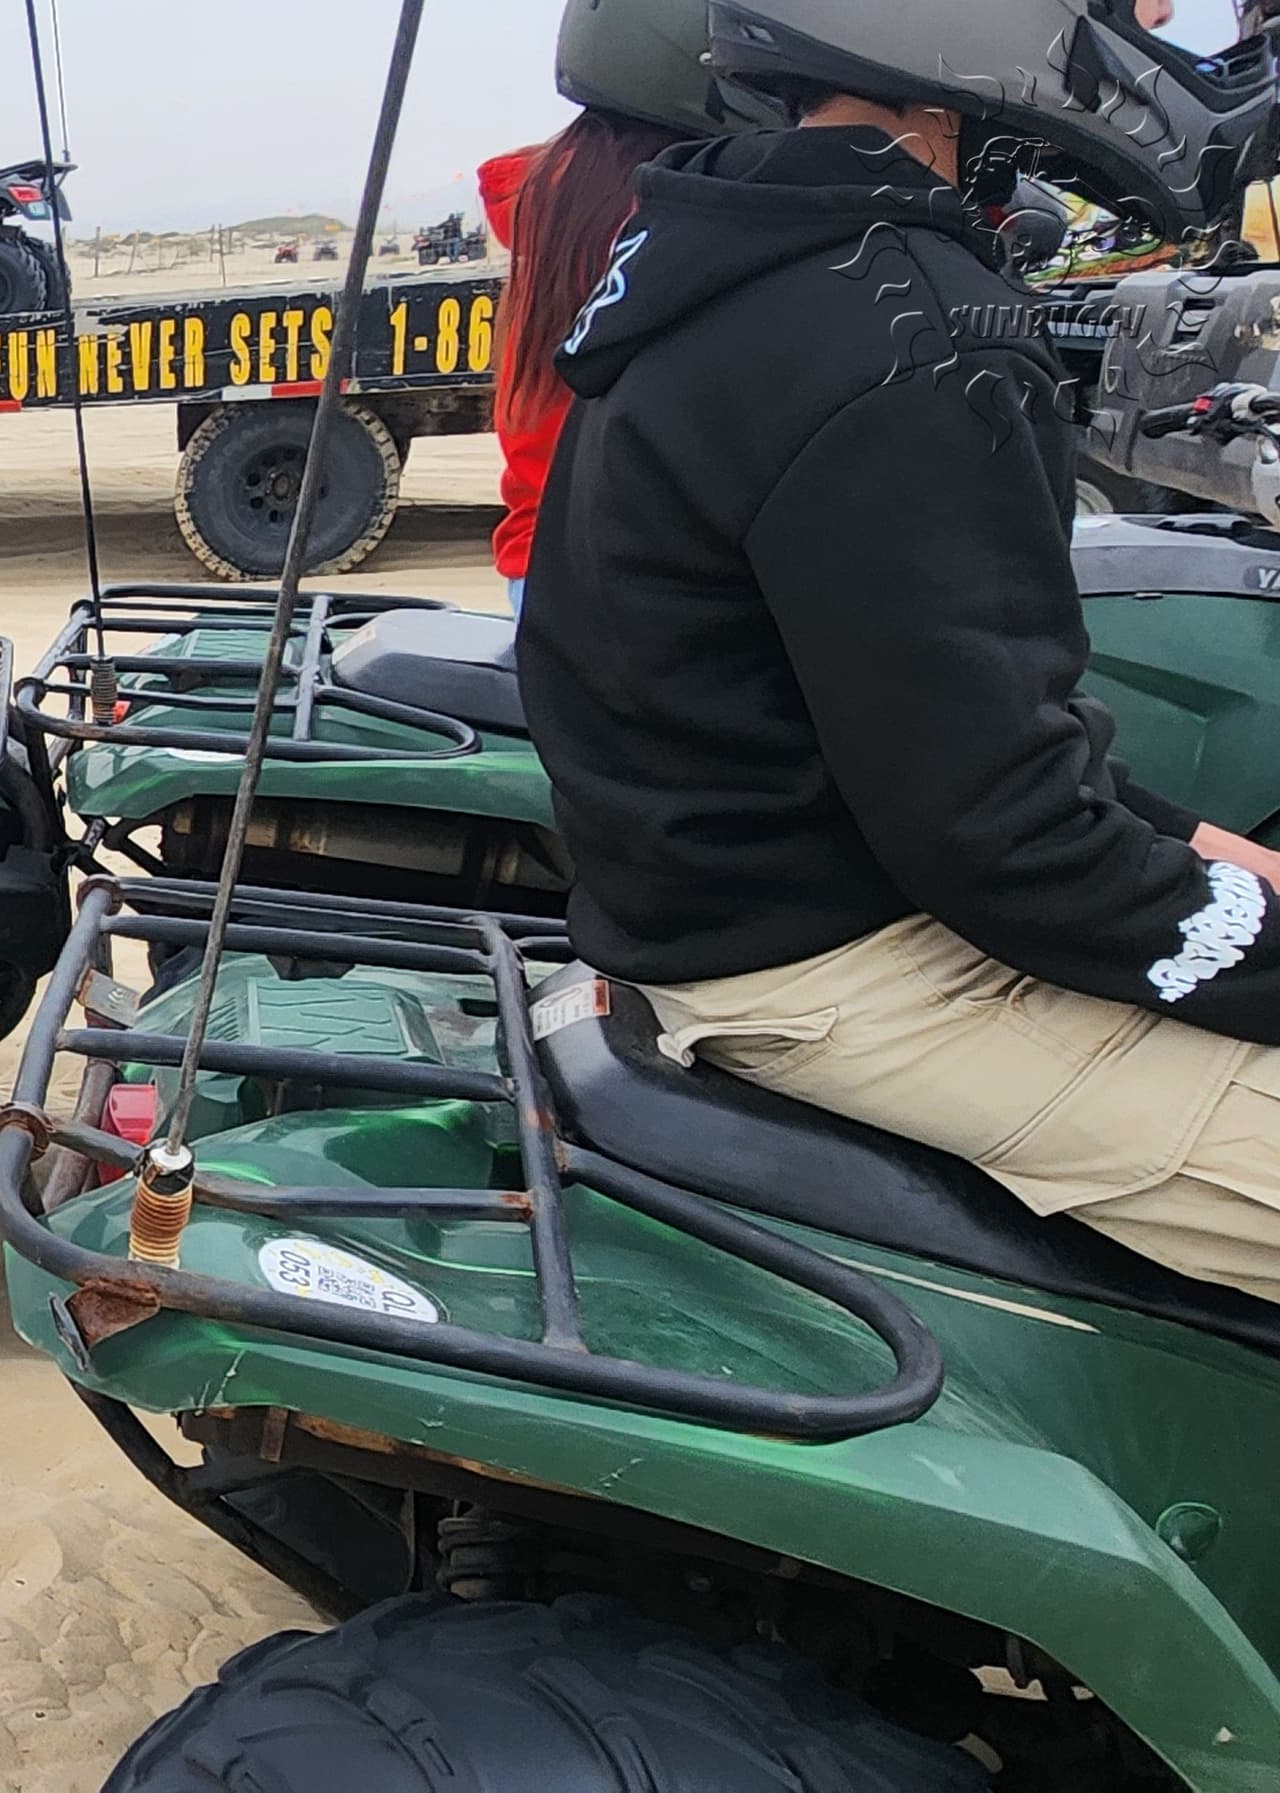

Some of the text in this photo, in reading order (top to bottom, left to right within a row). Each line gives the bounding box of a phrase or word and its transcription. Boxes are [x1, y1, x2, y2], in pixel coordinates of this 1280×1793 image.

[78, 317, 205, 395] NEVER
[230, 306, 333, 385] SETS
[279, 1249, 311, 1289] 053
